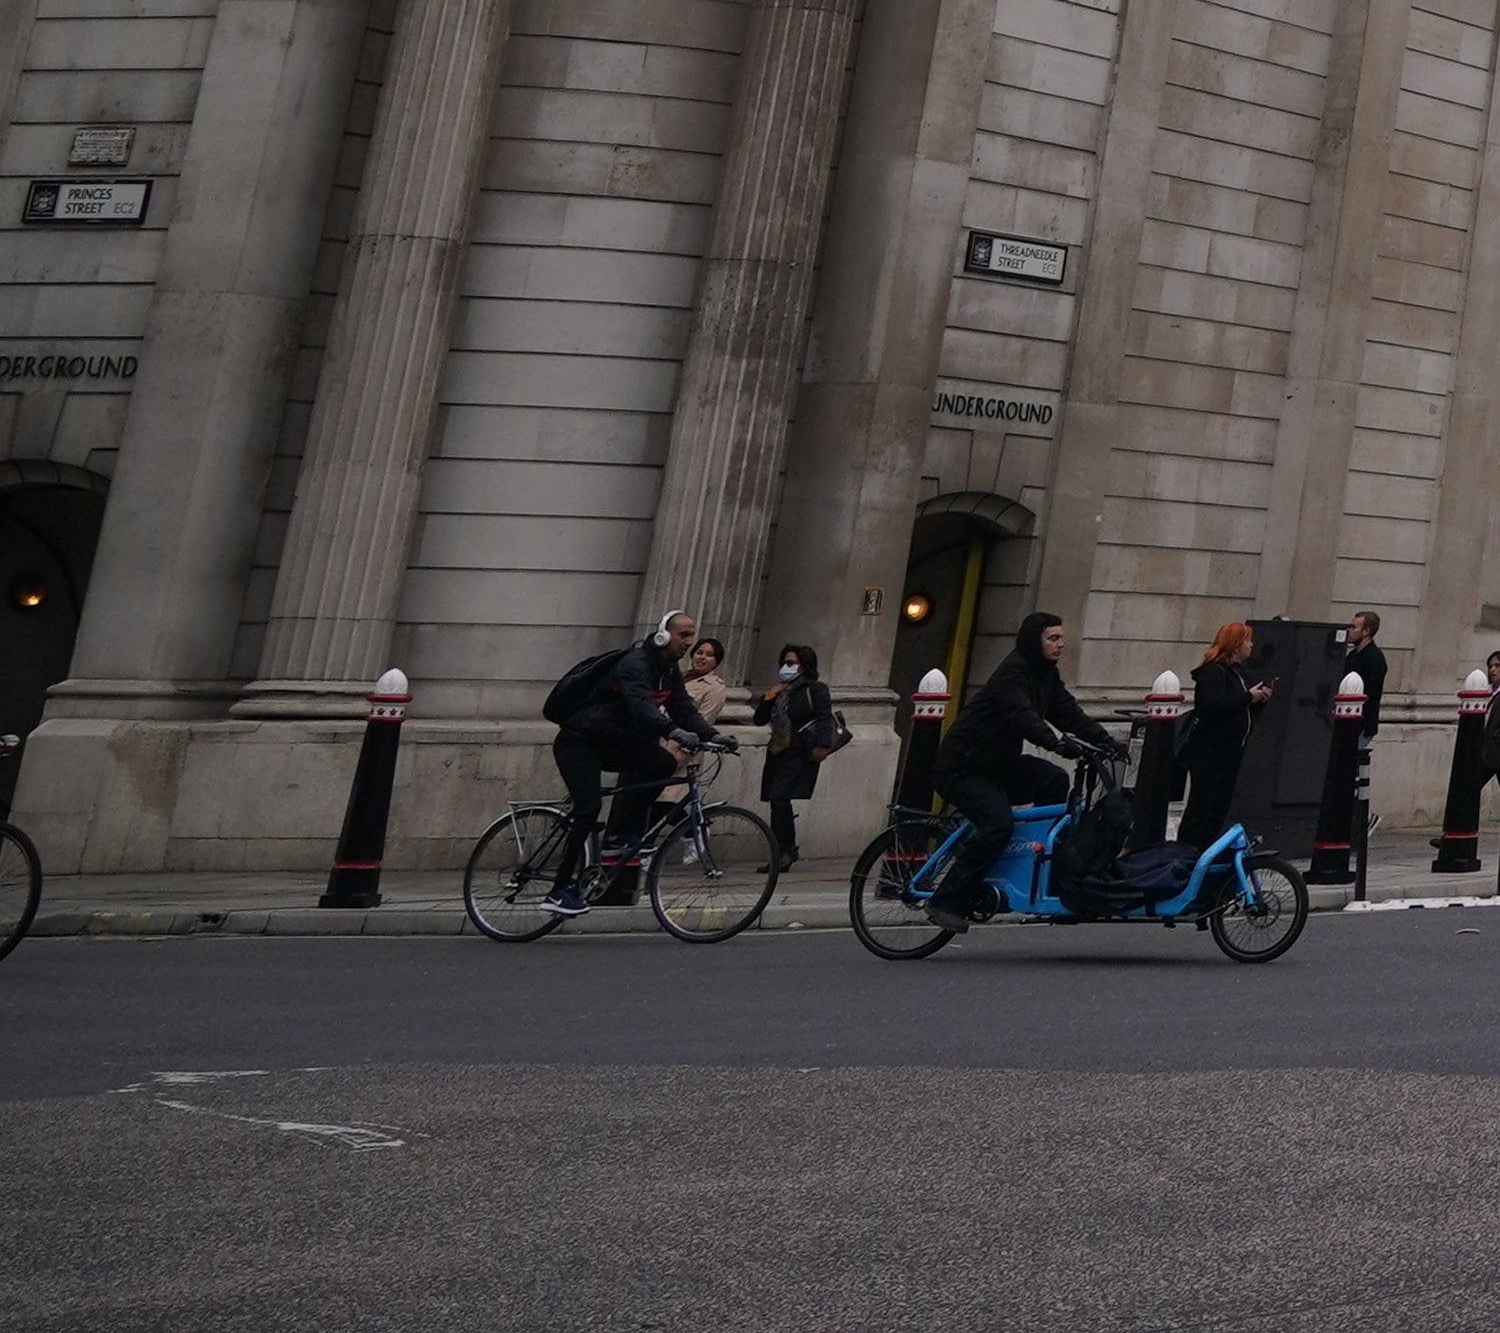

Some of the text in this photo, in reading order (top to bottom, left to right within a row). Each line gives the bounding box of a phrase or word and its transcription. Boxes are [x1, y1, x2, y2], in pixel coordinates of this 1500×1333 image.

[68, 188, 113, 200] PRINCES
[65, 202, 136, 214] STREET EC2
[1000, 243, 1058, 262] THREADNEEDLE
[998, 256, 1057, 274] STREET EC2
[0, 356, 138, 378] DERGROUND
